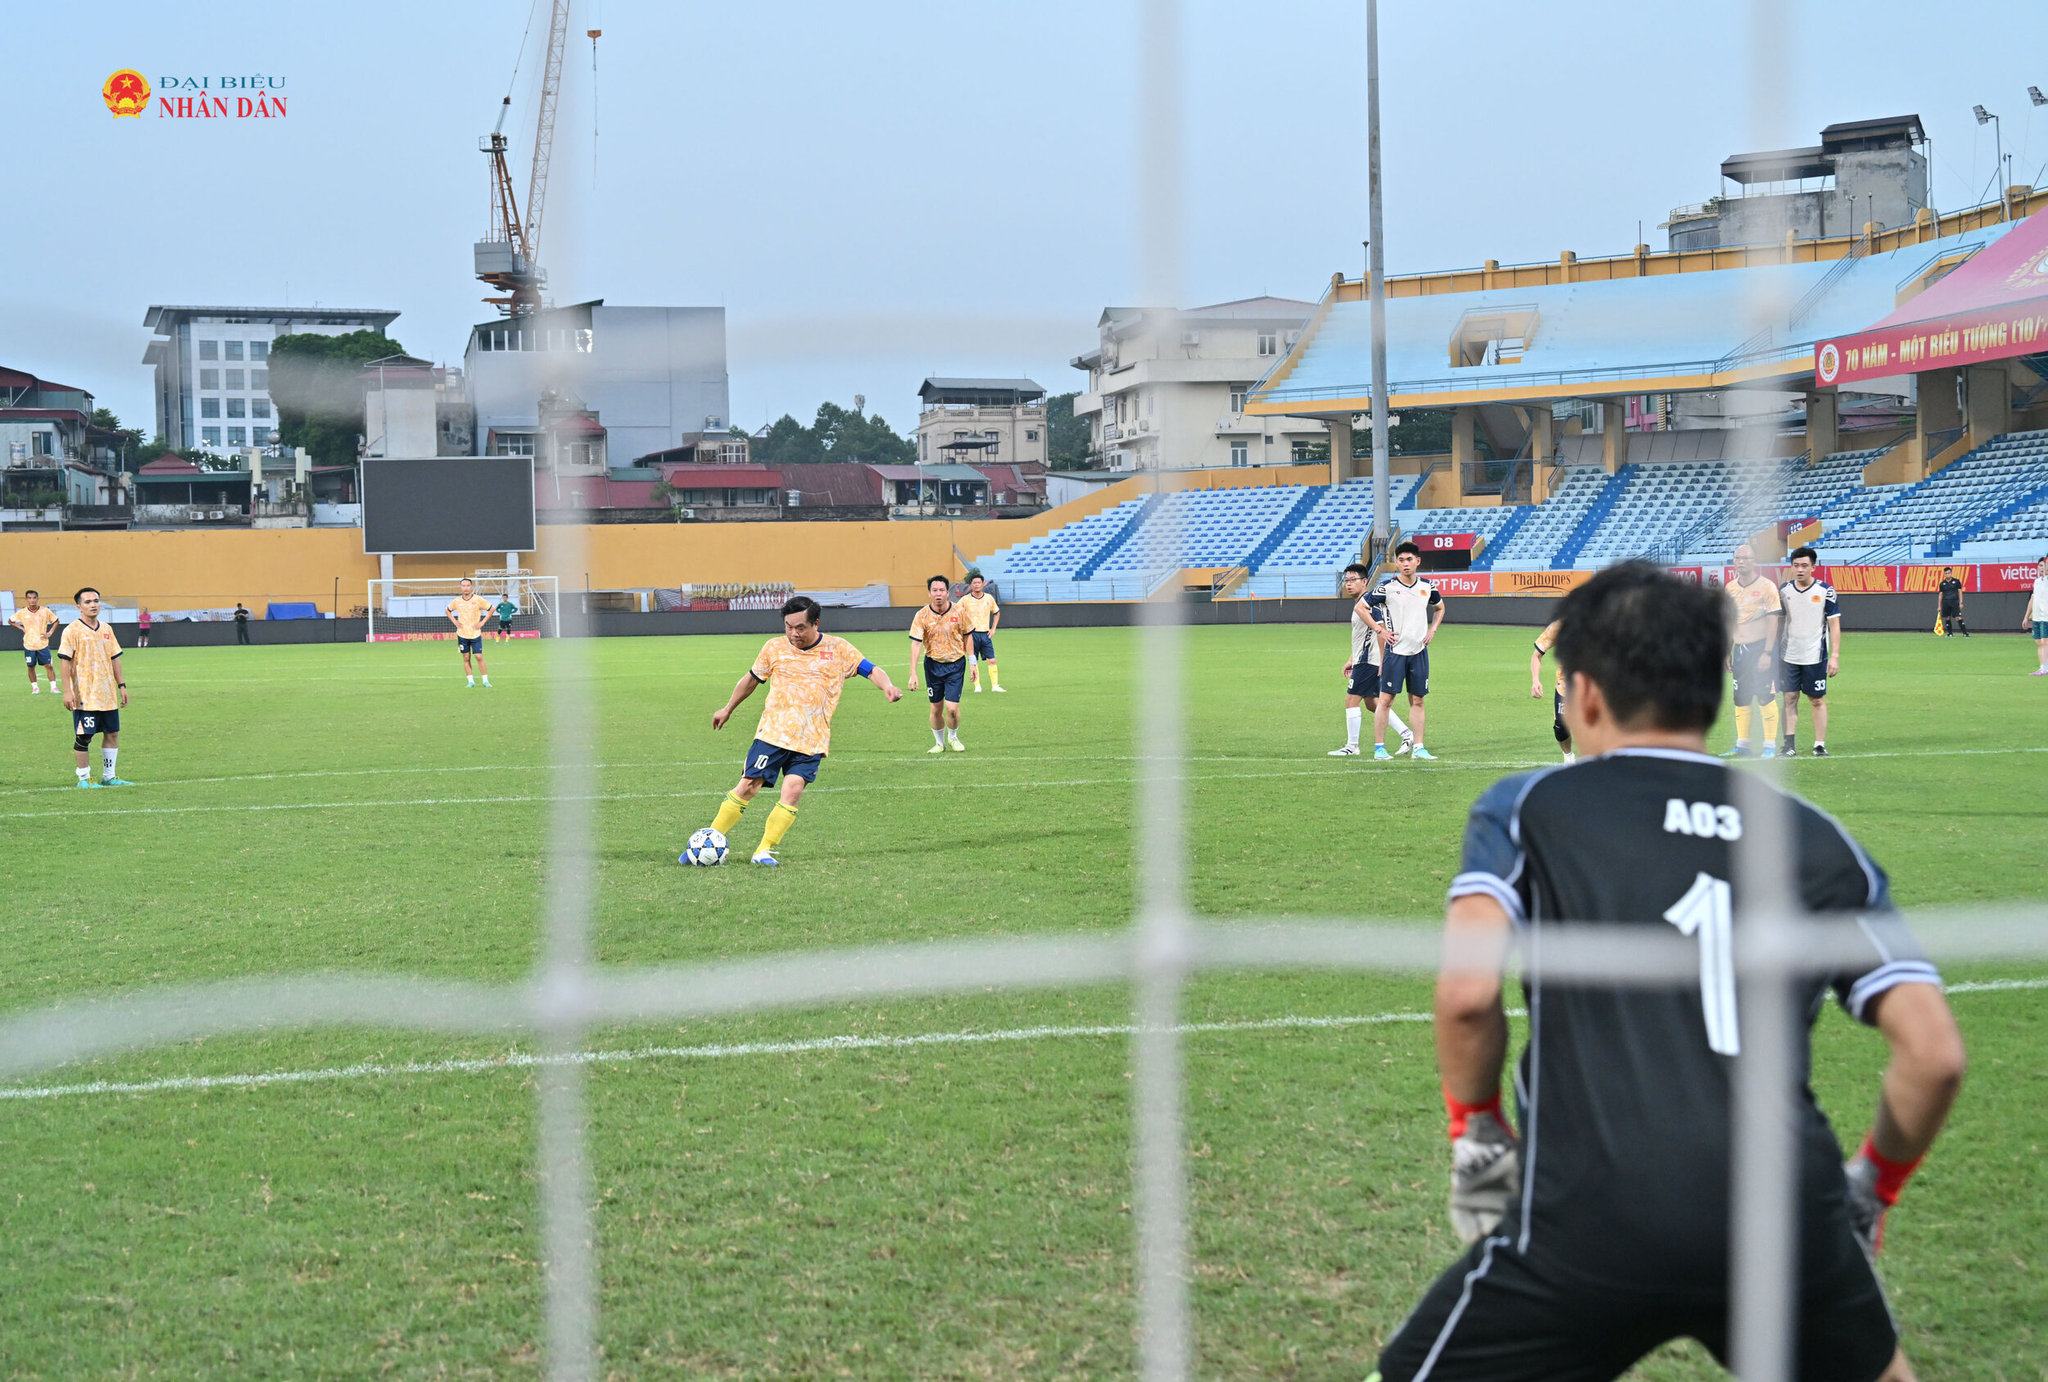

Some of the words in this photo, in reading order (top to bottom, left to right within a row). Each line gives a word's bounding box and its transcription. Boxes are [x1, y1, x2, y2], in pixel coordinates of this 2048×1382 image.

[1845, 348, 1859, 372] 70
[1862, 341, 1888, 369] NĂM
[1900, 334, 1927, 365] MỘT
[1930, 324, 1959, 358] BIỂU
[1962, 321, 2008, 354] TƯỢNG
[1434, 536, 1454, 548] 08
[1432, 578, 1449, 590] PT
[1451, 578, 1479, 593] Play
[1511, 572, 1571, 586] Thaihomes
[1904, 567, 1926, 591] OUR
[1814, 680, 1826, 691] 33
[84, 716, 95, 728] 35
[754, 754, 769, 770] 10
[1663, 798, 1743, 841] A03
[1662, 871, 1741, 1056] 1
